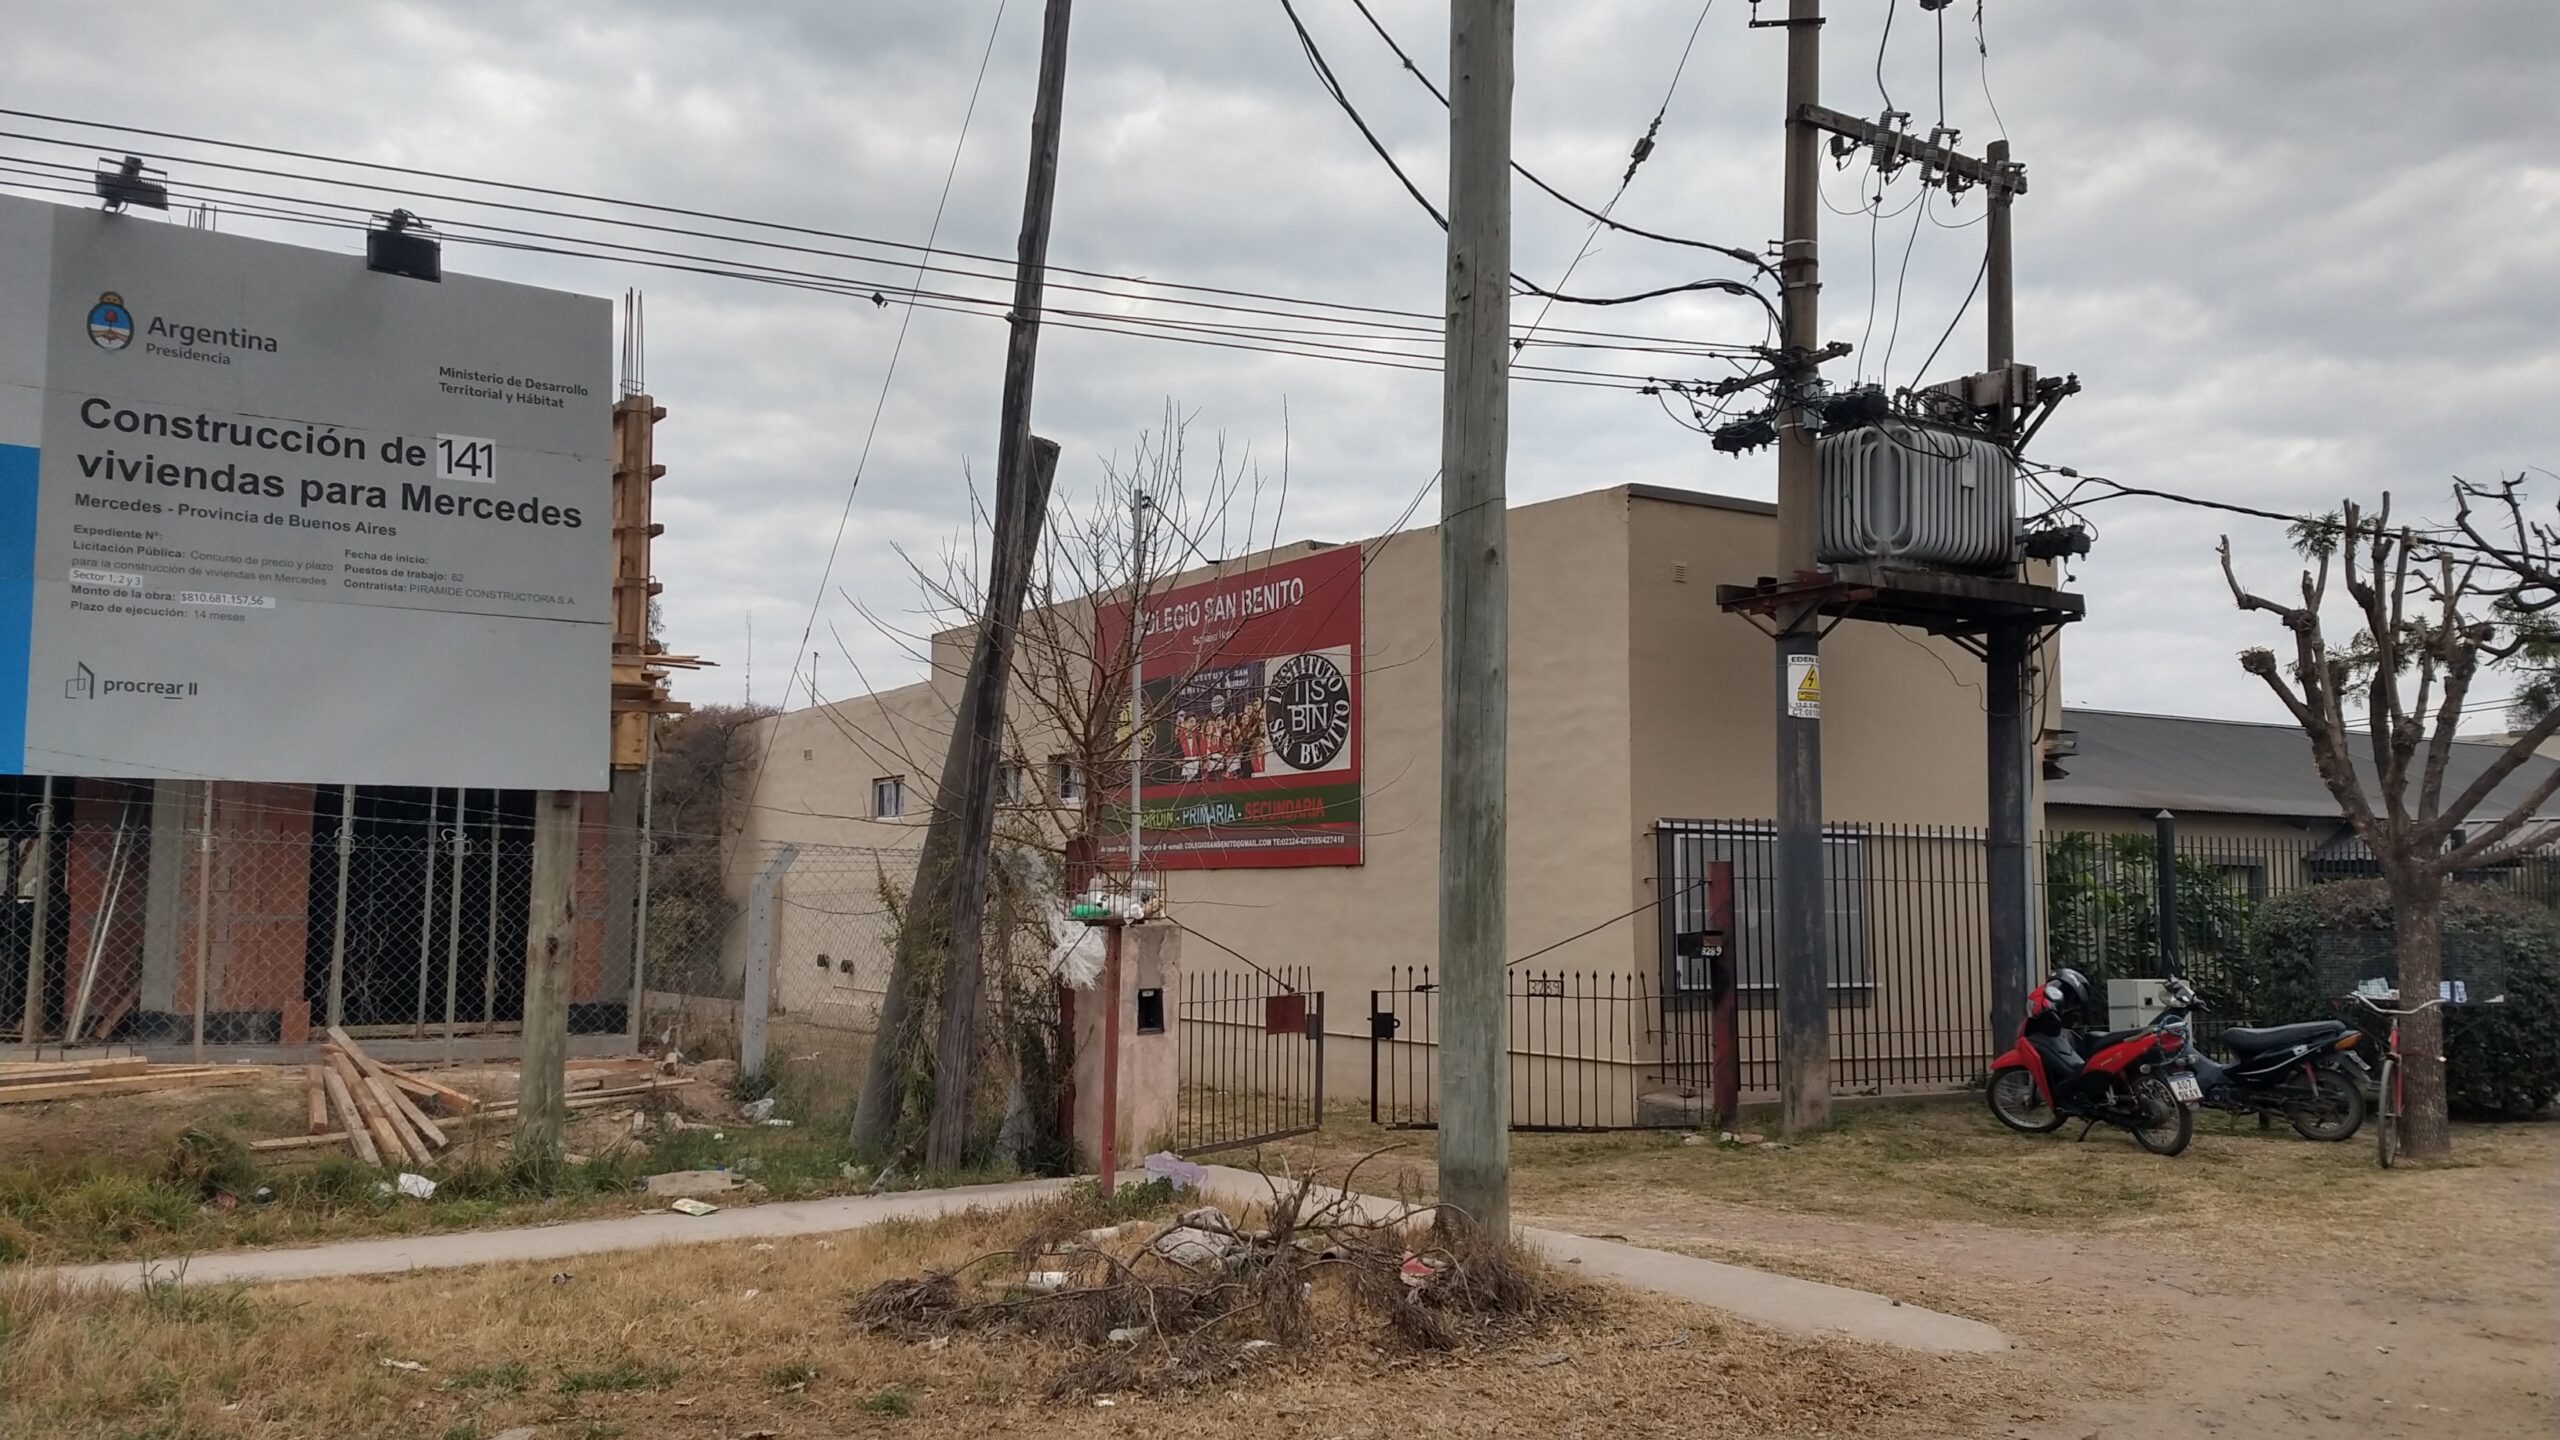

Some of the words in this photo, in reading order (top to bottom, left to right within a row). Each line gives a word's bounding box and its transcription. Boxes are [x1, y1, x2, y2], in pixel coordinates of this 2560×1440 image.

[147, 316, 277, 352] Argentina
[146, 343, 231, 365] Presidencia
[439, 366, 504, 385] Ministerio
[507, 376, 522, 387] de
[525, 378, 588, 396] Desarrollo
[439, 382, 502, 400] Territorial
[506, 393, 513, 404] y
[516, 392, 564, 408] Hábitat
[80, 397, 367, 460] Construcción
[380, 435, 427, 467] de
[438, 440, 494, 479] 141
[77, 448, 285, 497] viviendas
[301, 481, 387, 509] para
[402, 483, 583, 528] Mercedes
[75, 493, 162, 514] Mercedes
[178, 503, 259, 524] Provincia
[263, 512, 284, 526] de
[289, 514, 351, 532] Buenos
[355, 521, 397, 537] Aires
[73, 524, 142, 539] Expediente
[73, 540, 133, 554] Licitación
[137, 545, 186, 558] Pública:
[190, 550, 242, 564] Concurso
[245, 556, 259, 565] de
[261, 557, 294, 568] precio
[296, 561, 303, 570] y
[305, 560, 334, 572] plazo
[345, 549, 377, 560] Fecha
[380, 552, 393, 562] de
[396, 553, 429, 564] inicio:
[71, 557, 98, 568] para
[101, 559, 112, 568] la
[114, 559, 185, 574] construcción
[188, 566, 203, 576] de
[205, 568, 256, 581] viviendas
[258, 573, 272, 581] en
[275, 573, 327, 586] Mercedes
[73, 569, 105, 581] Sector
[119, 575, 125, 583] 2
[127, 577, 133, 586] y
[135, 576, 141, 585] 3
[344, 564, 388, 576] Puestos
[391, 569, 404, 577] de
[407, 569, 447, 582] trabajo:
[71, 585, 110, 597] Monto
[113, 588, 128, 598] de
[131, 589, 141, 599] la
[145, 591, 175, 601] obra:
[344, 579, 407, 592] Contratista:
[409, 584, 463, 597] PIRAMIDE
[465, 588, 556, 603] CONSTRUCTORA
[1204, 592, 1236, 622] SAN
[1242, 577, 1304, 615] BENITO
[70, 600, 104, 612] Plazo
[107, 604, 122, 613] de
[126, 605, 188, 618] ejecución:
[194, 609, 206, 619] 14
[210, 611, 246, 622] meses
[104, 680, 184, 695] procrear
[188, 682, 198, 695] II
[1269, 655, 1343, 705] INSTITUTO
[1269, 718, 1295, 758] SAN
[1300, 700, 1349, 764] BENITO
[1141, 808, 1174, 827] ARDIN
[1182, 804, 1236, 824] PRIMARIA
[1244, 798, 1325, 820] SECUNDARIA
